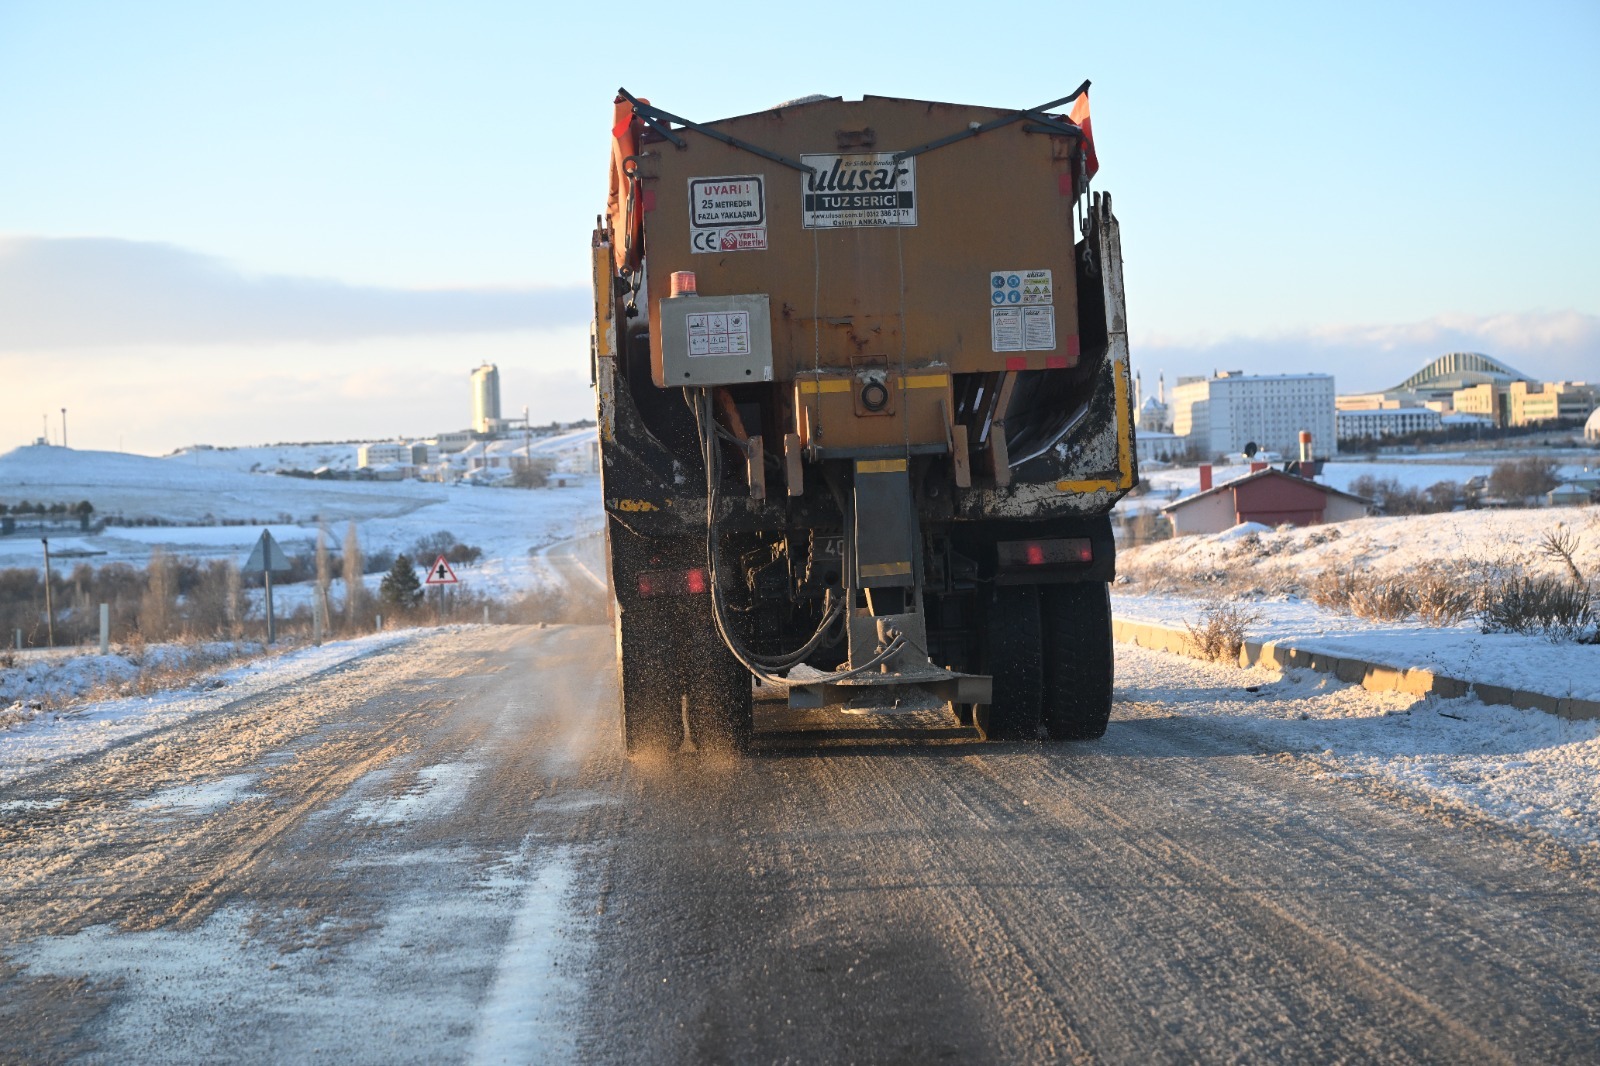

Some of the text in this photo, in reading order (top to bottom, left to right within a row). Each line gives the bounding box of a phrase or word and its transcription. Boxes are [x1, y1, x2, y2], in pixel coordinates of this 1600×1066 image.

[807, 158, 909, 191] ulusar
[704, 184, 750, 196] UYARI !
[702, 200, 752, 209] 25 METREDEN
[822, 197, 850, 208] TUZ
[721, 211, 757, 220] YAKLAŞMA
[693, 231, 717, 250] CE
